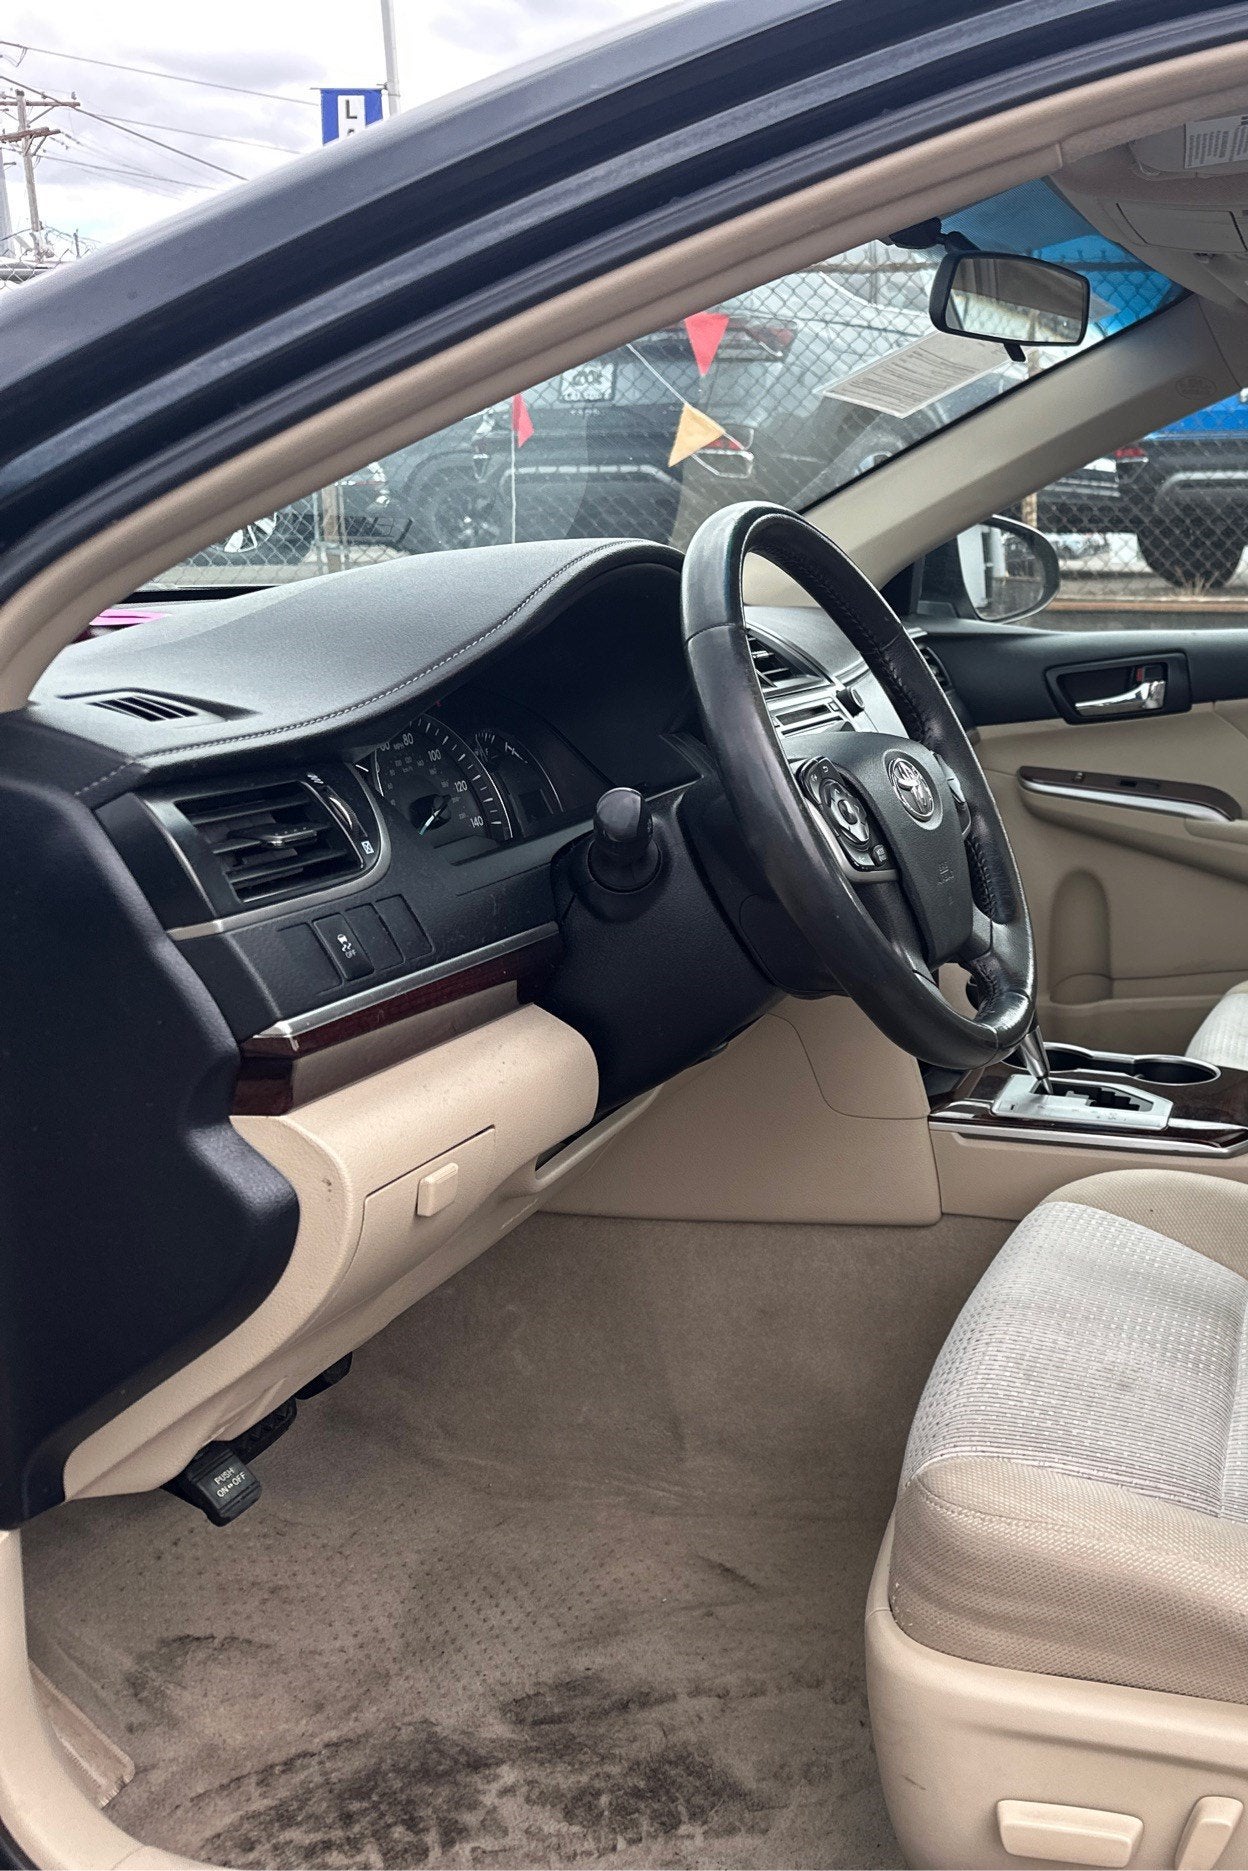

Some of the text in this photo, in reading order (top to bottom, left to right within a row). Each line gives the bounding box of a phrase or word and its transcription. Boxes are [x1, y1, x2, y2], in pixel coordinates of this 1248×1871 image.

[402, 733, 413, 746] 80
[428, 749, 441, 761] 100
[455, 781, 467, 792] 120
[470, 816, 483, 828] 140
[214, 1467, 235, 1485] PUSH
